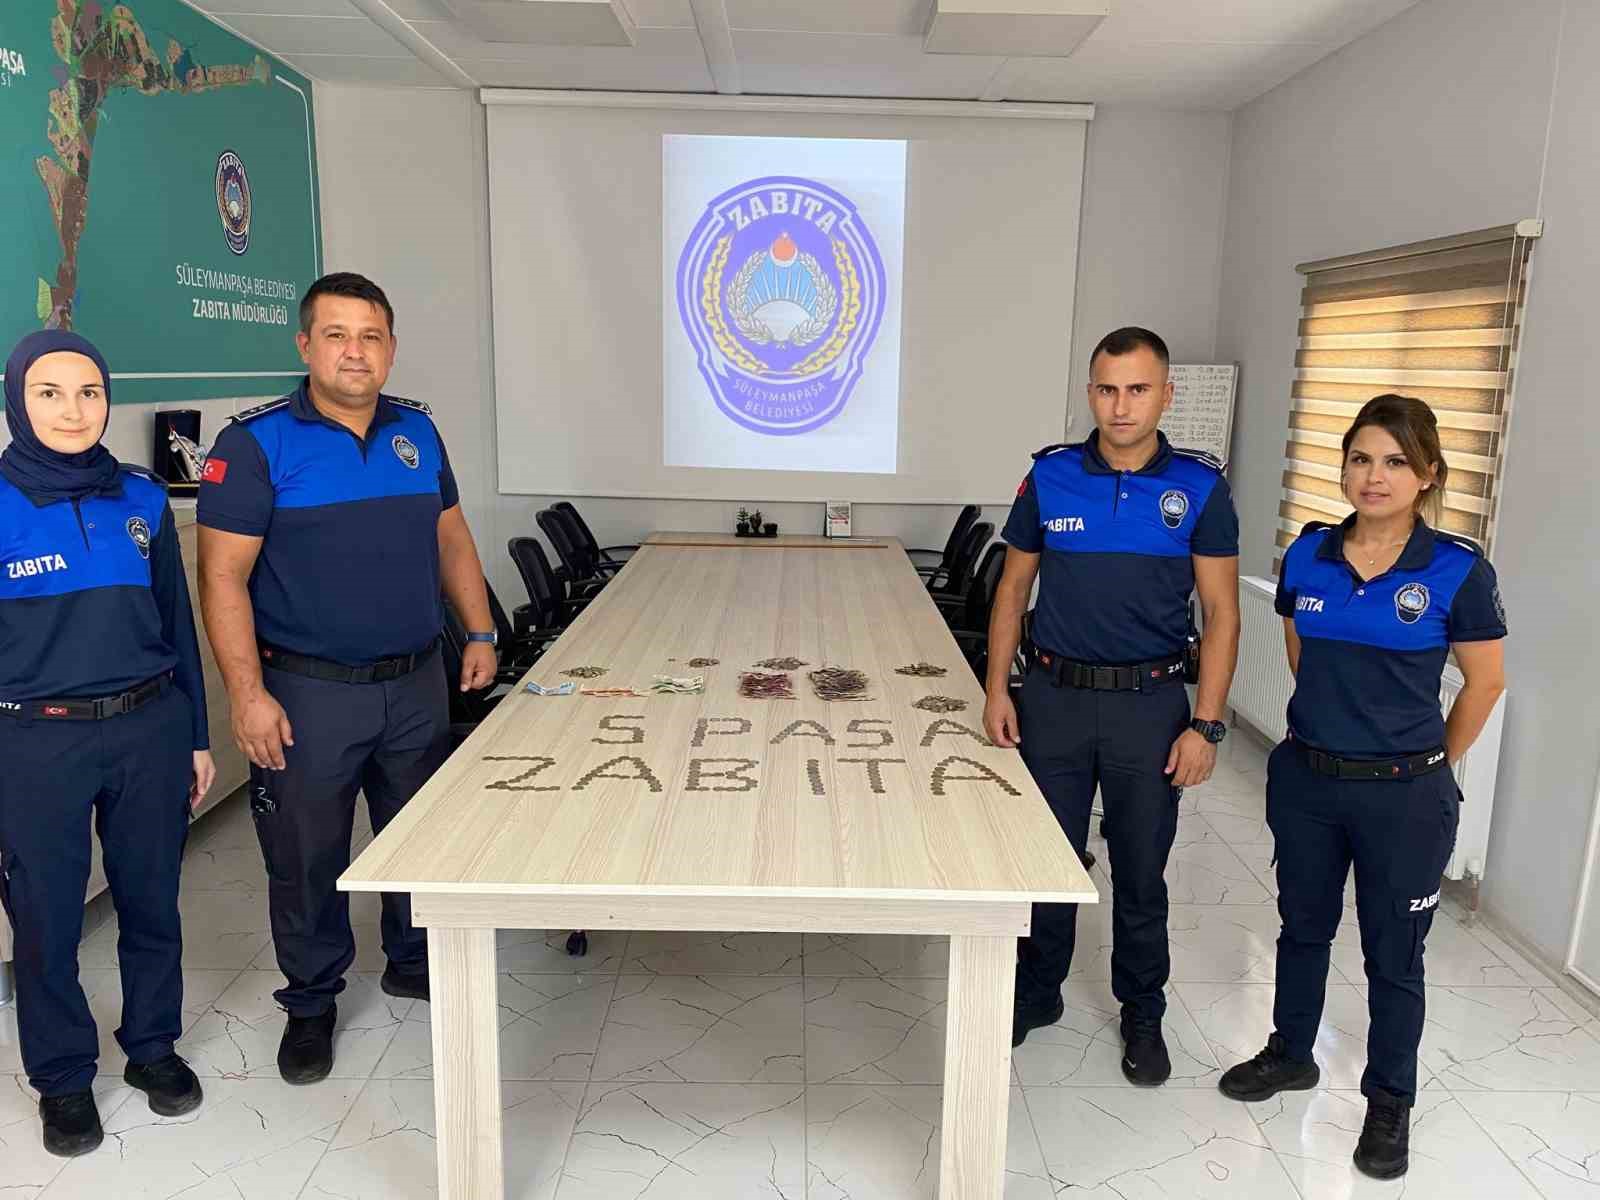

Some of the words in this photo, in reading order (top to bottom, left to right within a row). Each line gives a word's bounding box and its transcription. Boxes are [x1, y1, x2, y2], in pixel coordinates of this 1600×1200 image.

[176, 262, 254, 298] SÜLEYMANPAŞA
[254, 278, 296, 301] BELEDİYESİ
[192, 298, 231, 320] ZABITA
[231, 300, 288, 325] MÜDÜRLÜĞÜ
[6, 553, 68, 579] ZABITA
